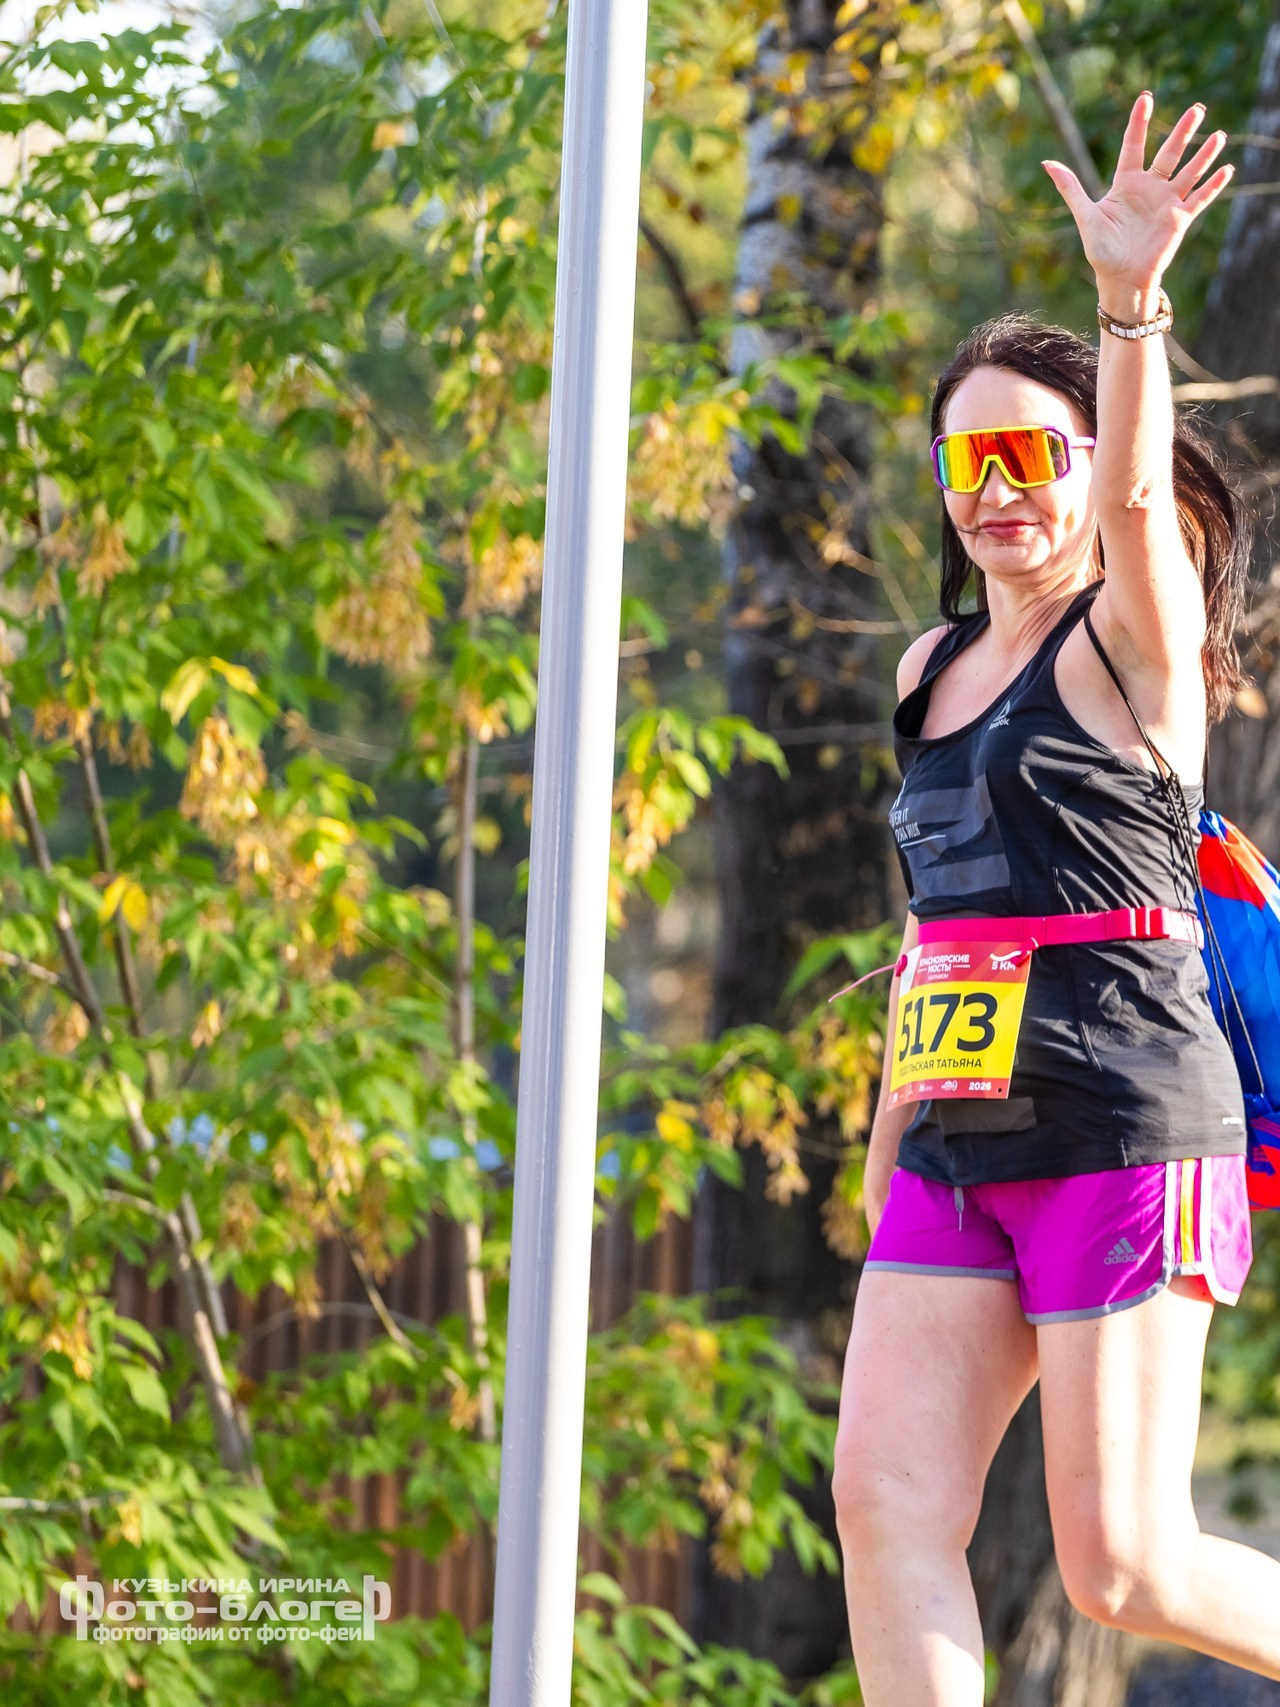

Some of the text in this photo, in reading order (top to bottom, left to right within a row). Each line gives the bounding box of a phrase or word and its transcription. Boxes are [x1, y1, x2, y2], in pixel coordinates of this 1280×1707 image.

[991, 962, 998, 970] 5
[899, 992, 998, 1062] 5173
[937, 1058, 982, 1069] ТАТЬЯНА
